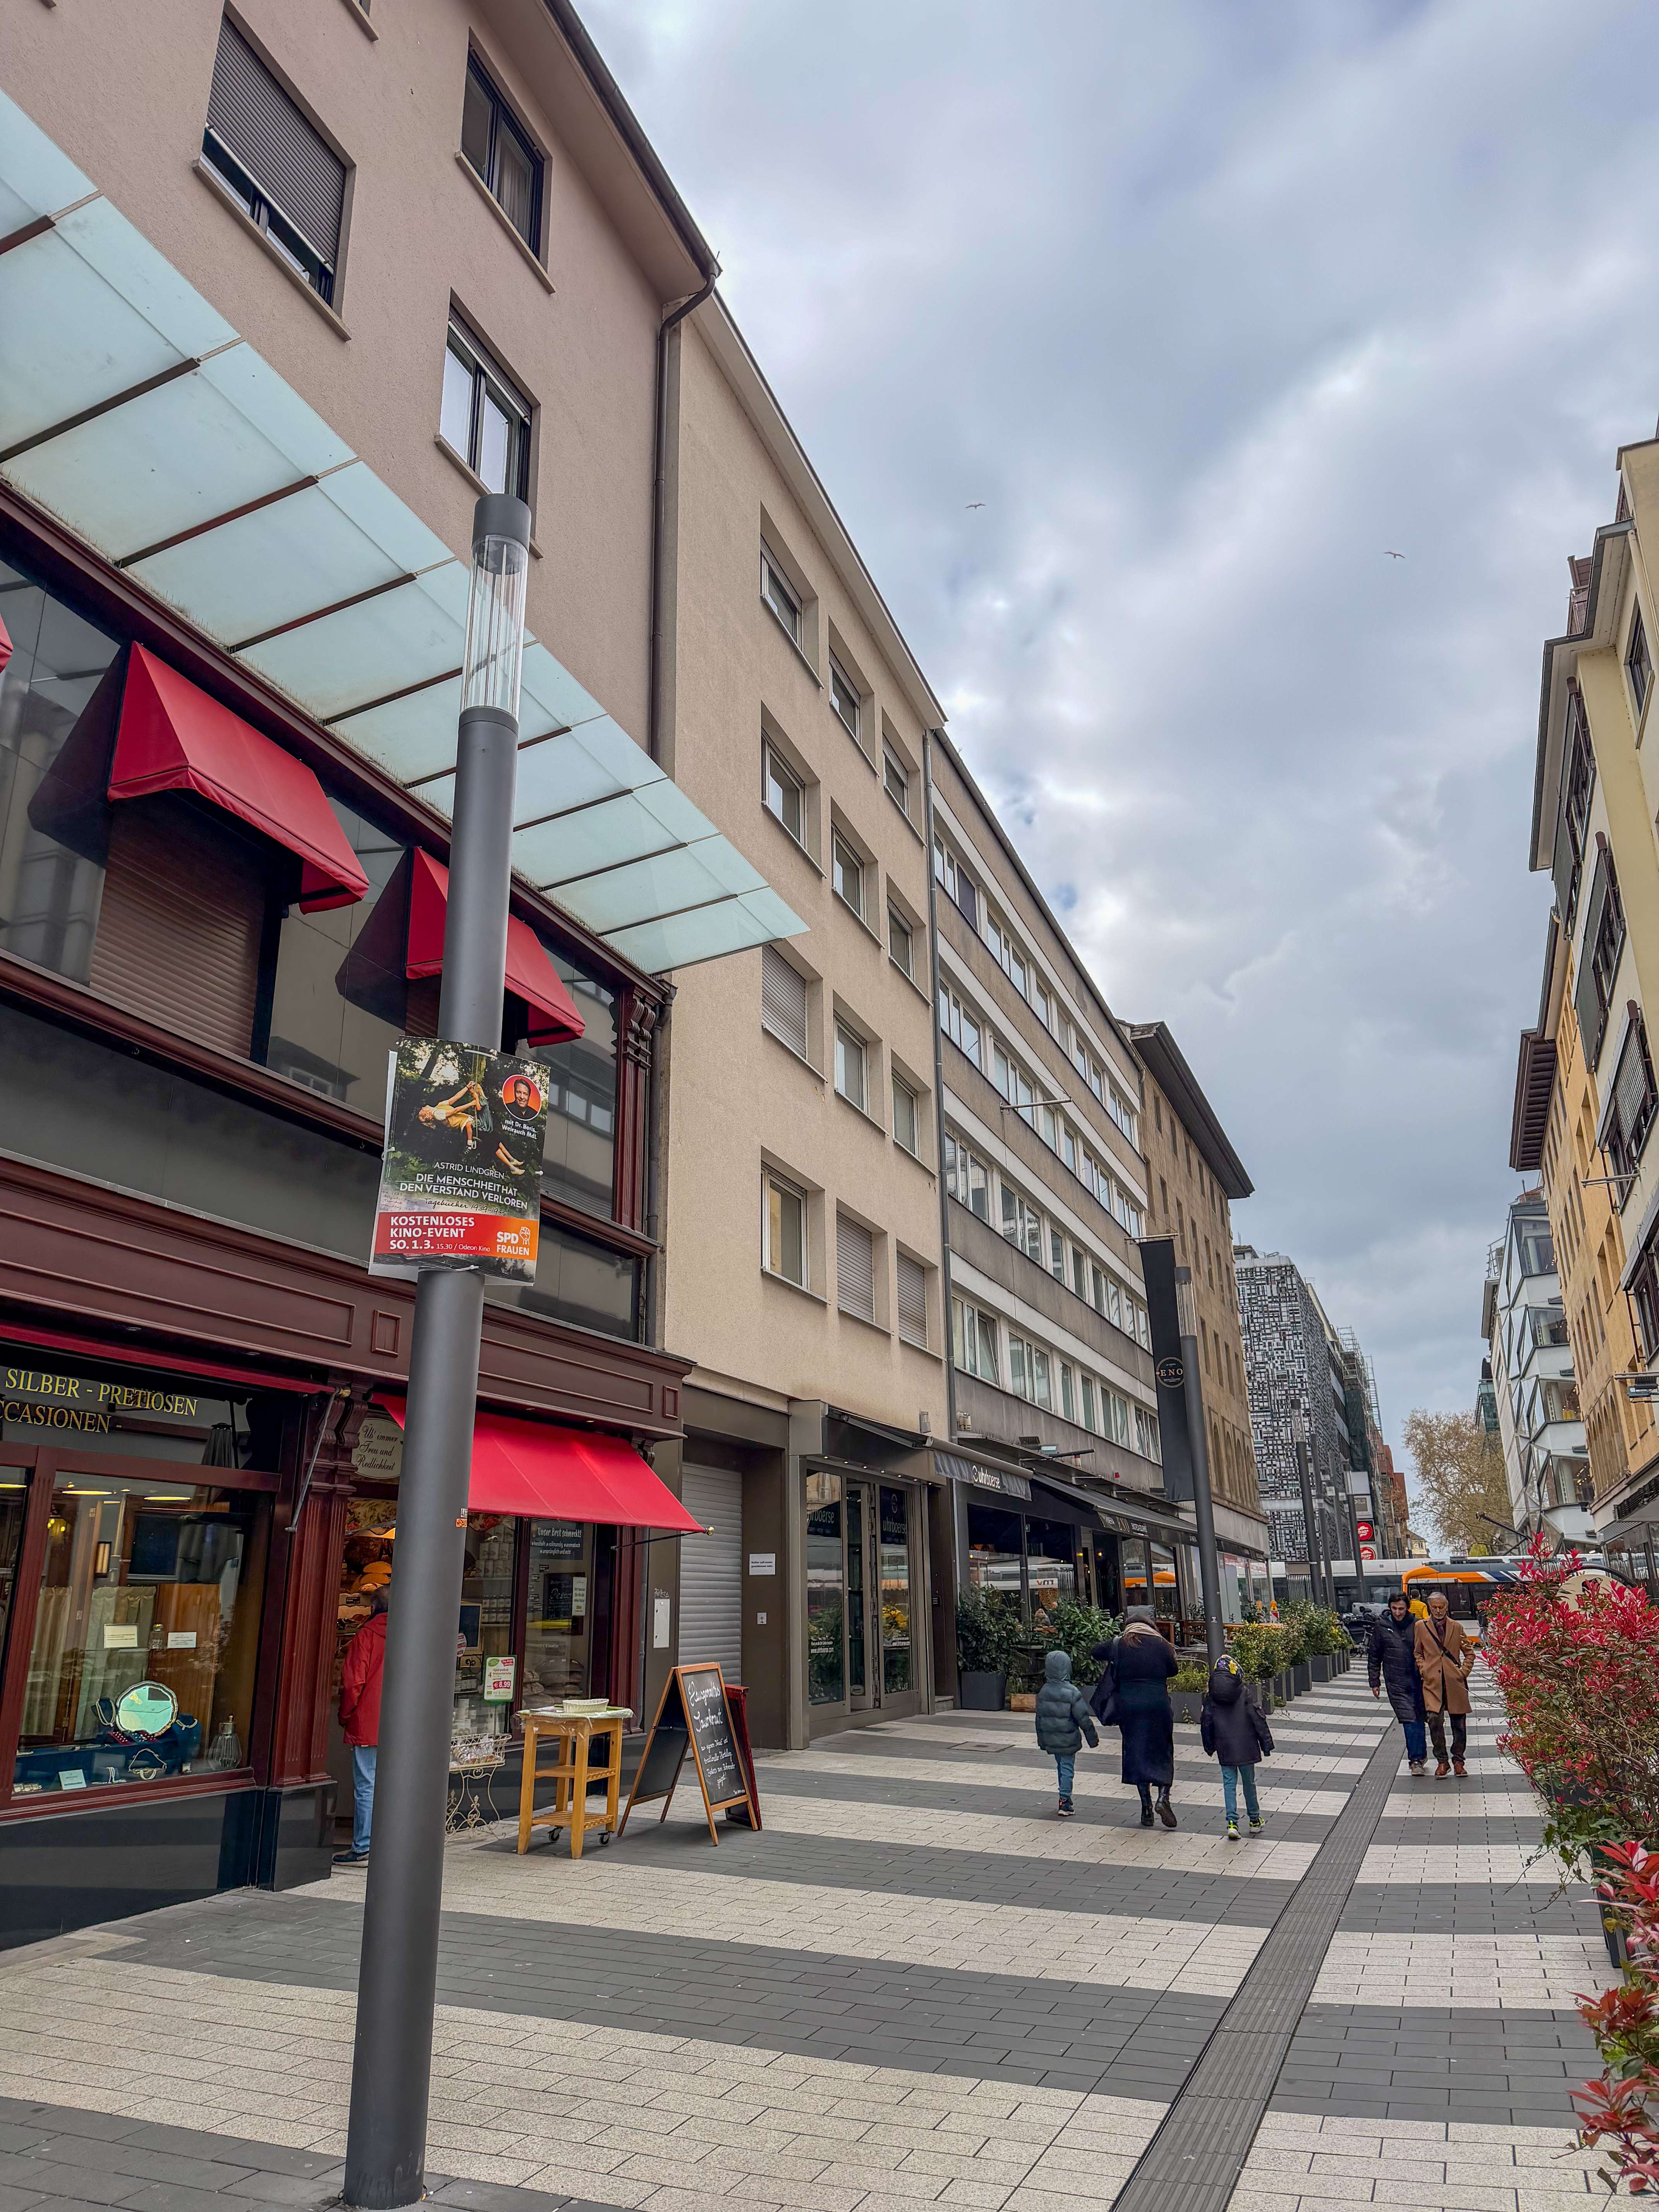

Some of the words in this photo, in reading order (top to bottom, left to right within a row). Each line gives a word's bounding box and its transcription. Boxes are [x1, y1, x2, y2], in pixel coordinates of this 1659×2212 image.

[502, 1124, 526, 1136] Weirauch
[527, 1131, 537, 1139] MdL
[523, 1123, 536, 1132] Boris
[434, 1162, 463, 1171] ASTRID
[465, 1165, 505, 1180] LINDGREN
[416, 1173, 434, 1183] DIE
[436, 1175, 501, 1193] MENSCHHEIT
[502, 1185, 517, 1197] HAT
[400, 1183, 423, 1192] DEN
[425, 1184, 479, 1198] VERSTAND
[481, 1191, 527, 1210] VERLOREN
[424, 1198, 468, 1209] Tagebücher
[471, 1204, 506, 1216] 1939-1945
[391, 1216, 475, 1227] KOSTENLOSES
[390, 1228, 465, 1238] KINO-EVENT
[496, 1231, 519, 1243] SPD
[390, 1240, 409, 1250] SO.
[497, 1245, 529, 1255] FRAUEN
[1160, 1368, 1183, 1376] ENO
[5, 1369, 80, 1399] SILBER
[97, 1383, 198, 1416] PRETIOSEN
[0, 1400, 112, 1434] CASIONEN
[377, 1432, 398, 1442] immer
[359, 1441, 378, 1453] Treu
[380, 1446, 395, 1456] und
[356, 1453, 395, 1471] Redlichkeit
[978, 1467, 1000, 1489] uhrboerse
[538, 1527, 551, 1536] Unser
[552, 1527, 561, 1537] Brot
[562, 1528, 582, 1538] schmeckt!
[883, 1517, 907, 1535] uhrboerse
